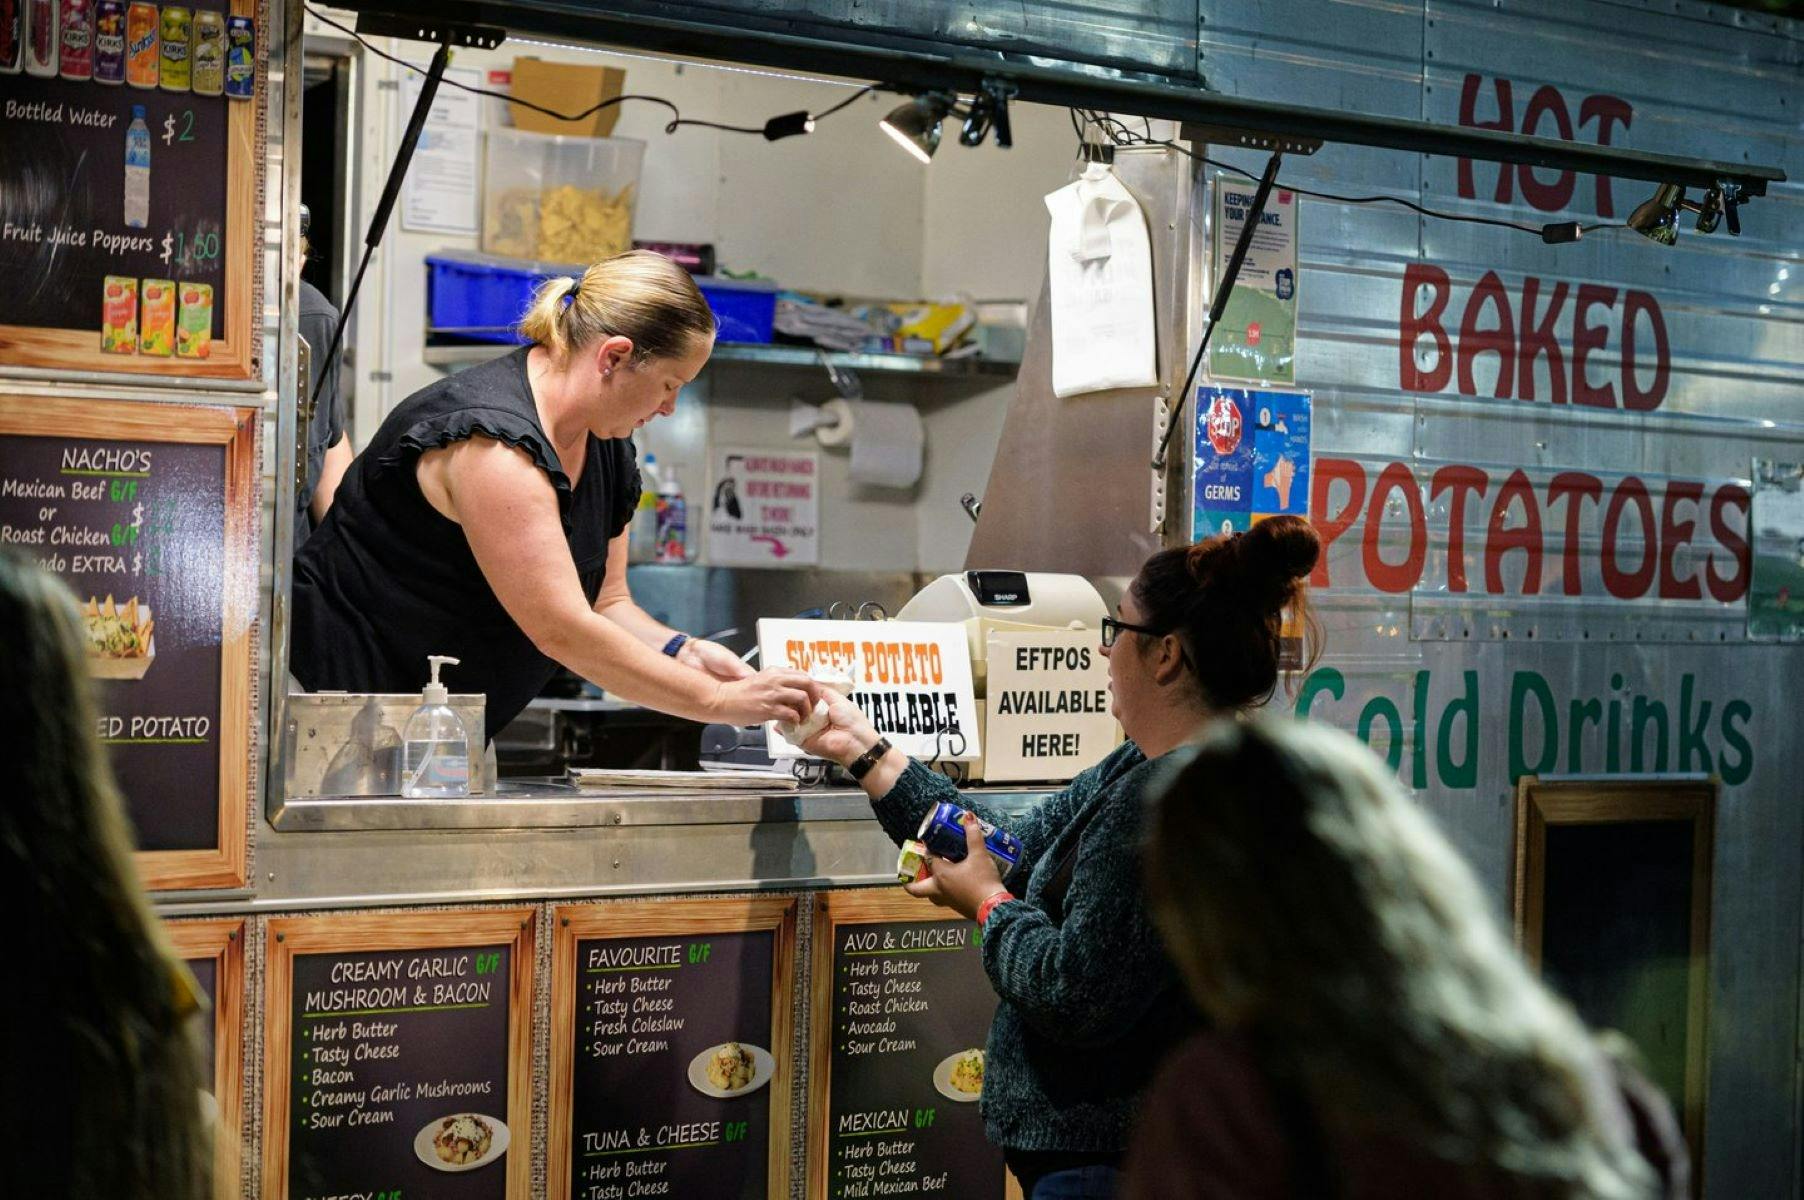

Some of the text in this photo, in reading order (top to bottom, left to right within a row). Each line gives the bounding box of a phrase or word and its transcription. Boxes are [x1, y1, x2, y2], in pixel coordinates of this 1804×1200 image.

[6, 100, 62, 123] Bottled
[69, 107, 117, 128] Water
[1457, 73, 1633, 217] HOT
[2, 223, 41, 241] Fruit
[48, 227, 86, 247] Juice
[92, 229, 153, 255] Poppers
[1400, 263, 1671, 412] BAKED
[61, 448, 152, 472] NACHO'S
[2, 478, 138, 501] Mexican Beef G/F
[1205, 485, 1240, 501] GERMS
[39, 507, 57, 521] or
[1, 525, 44, 543] Roast
[51, 526, 110, 545] Chicken
[1311, 457, 1751, 602] POTATOES
[72, 555, 126, 574] EXTRA
[994, 593, 1018, 601] SHARP
[862, 641, 943, 685] POTATO
[1016, 647, 1091, 671] EFTPOS
[998, 690, 1106, 714] AVAILABLE
[846, 692, 960, 735] VAILABLE
[131, 716, 209, 738] POTATO
[1509, 671, 1754, 787] Drinks
[1022, 733, 1080, 757] HERE!
[844, 932, 878, 951] AVO
[883, 931, 895, 949] &
[901, 928, 967, 949] CHICKEN
[589, 943, 711, 968] FAVOURITE G/F
[331, 953, 500, 984] CREAMY GARLIC G/F
[851, 959, 920, 976] Herb Butter
[595, 976, 672, 994] Herb Butter
[850, 978, 922, 998] Tasty Cheese
[305, 982, 490, 1013] MUSHROOM & BACON
[595, 997, 674, 1018] Tasty Cheese
[849, 997, 929, 1015] Roast Chicken
[312, 1022, 398, 1041] Herb Butter
[594, 1016, 684, 1037] Fresh Coleslaw
[848, 1019, 897, 1035] Avocado
[312, 1043, 399, 1066] Tasty Cheese
[592, 1038, 668, 1057] Sour Cream
[848, 1037, 916, 1055] Sour Cream
[312, 1069, 354, 1085] Bacon
[311, 1080, 491, 1108] Creamy Garlic Mushrooms
[310, 1109, 394, 1130] Sour Cream
[839, 1108, 936, 1132] MEXICAN G/F
[583, 1121, 748, 1151] TUNA & CHEESE G/F
[844, 1140, 915, 1159] Herb Butter
[590, 1160, 667, 1181] Herb Butter
[844, 1159, 917, 1180] Tasty Cheese
[590, 1180, 669, 1200] Tasty Cheese
[844, 1172, 947, 1197] Mild Mexican Beef
